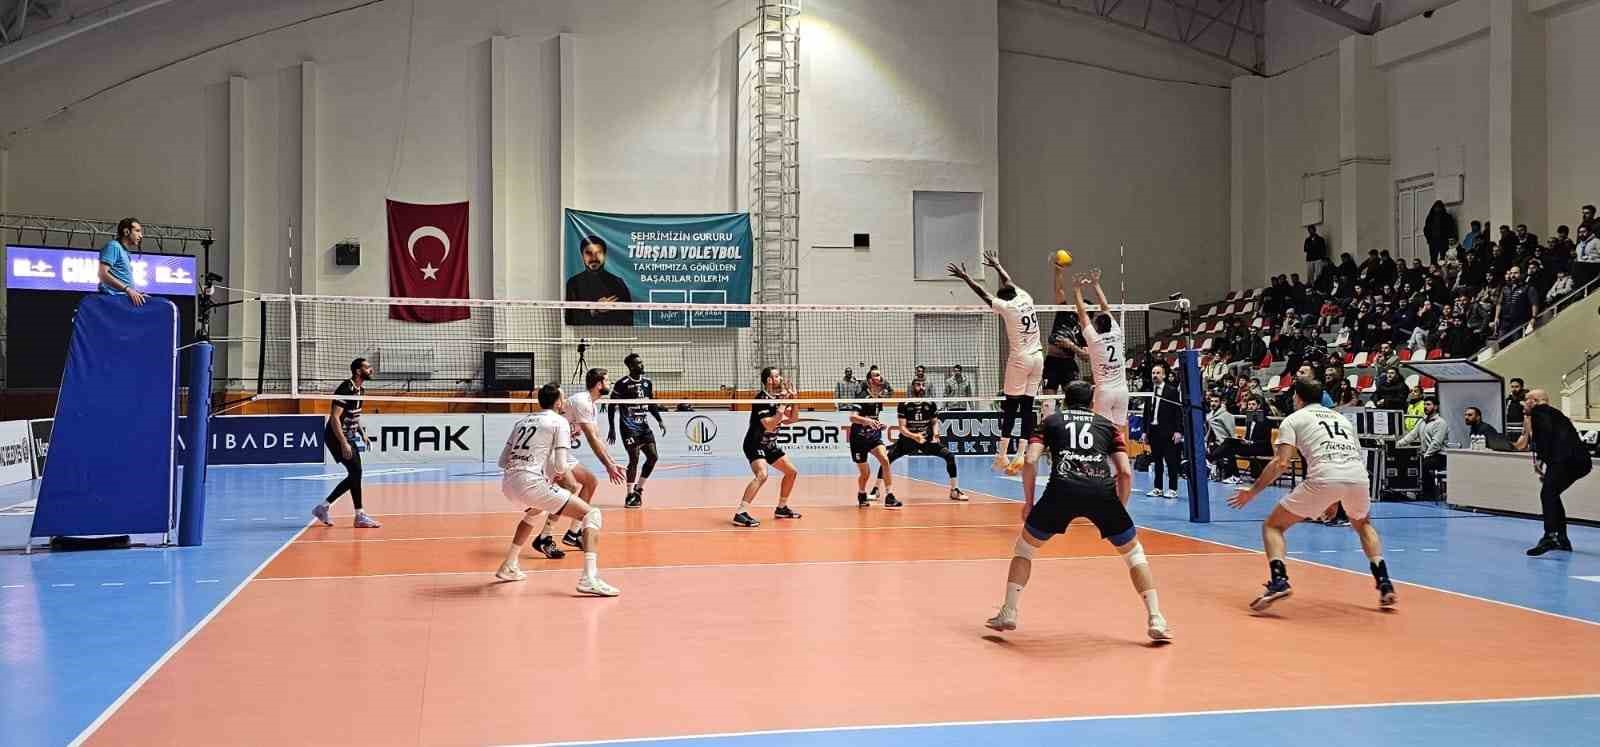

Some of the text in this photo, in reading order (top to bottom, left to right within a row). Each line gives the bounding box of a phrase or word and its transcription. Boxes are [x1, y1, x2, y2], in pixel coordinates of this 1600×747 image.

[631, 231, 733, 242] ŞEHRİMİZİN GURURU
[628, 242, 742, 261] TÜRŞAD VOLEYBOL
[690, 262, 737, 272] GÖNÜLDEN
[640, 273, 730, 284] BAŞARILAR DİLERİM
[1106, 345, 1118, 363] 2
[513, 426, 537, 449] 22
[1065, 422, 1094, 449] 16
[1319, 420, 1348, 439] 14
